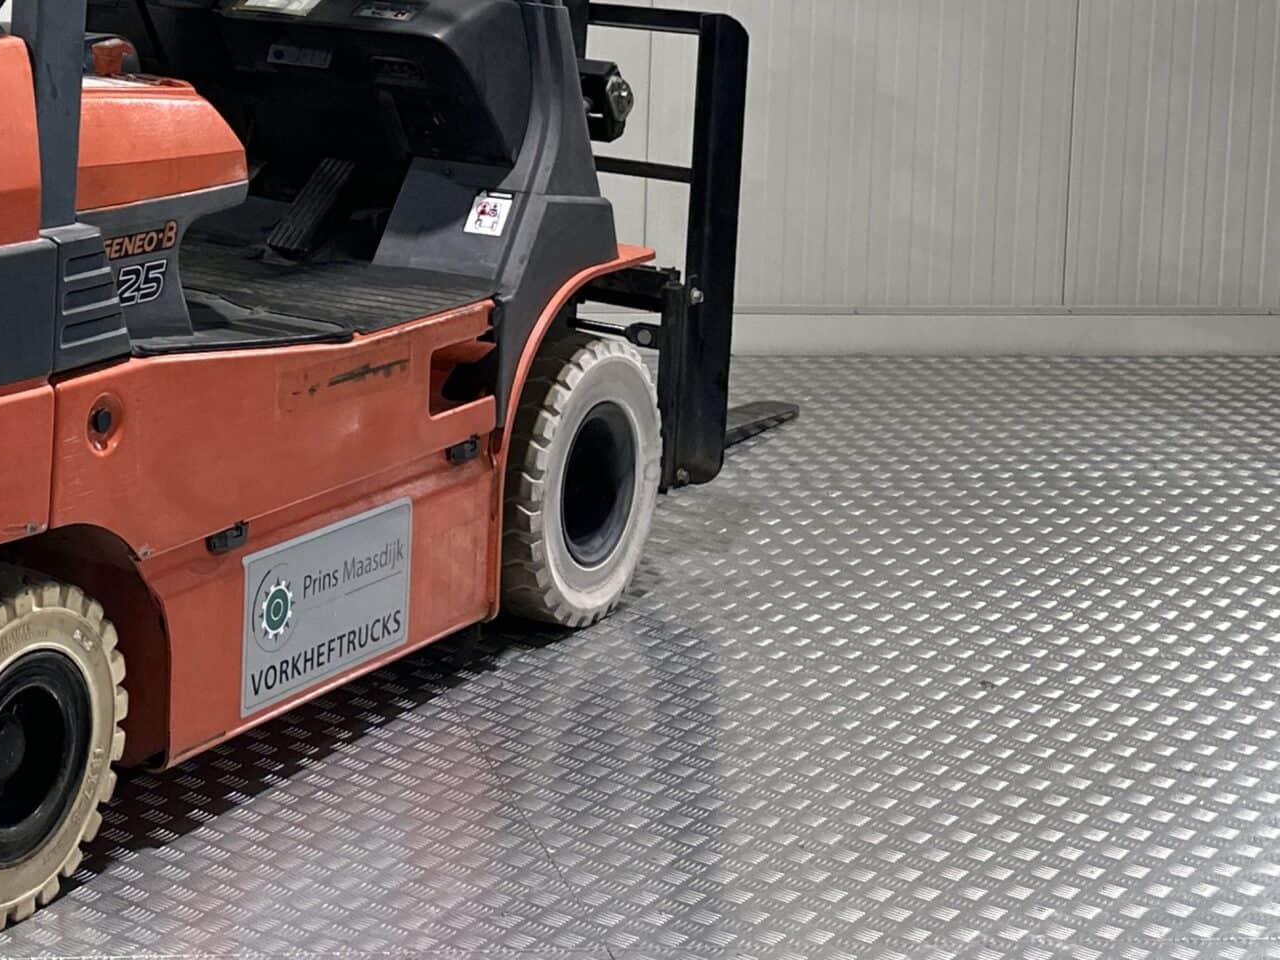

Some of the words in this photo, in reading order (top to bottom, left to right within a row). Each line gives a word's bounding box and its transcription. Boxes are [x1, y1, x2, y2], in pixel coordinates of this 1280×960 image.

[117, 259, 167, 307] 25
[303, 569, 339, 600] Prins
[342, 538, 405, 584] Maasdijk
[251, 610, 401, 696] VORKHEFTRUCKS
